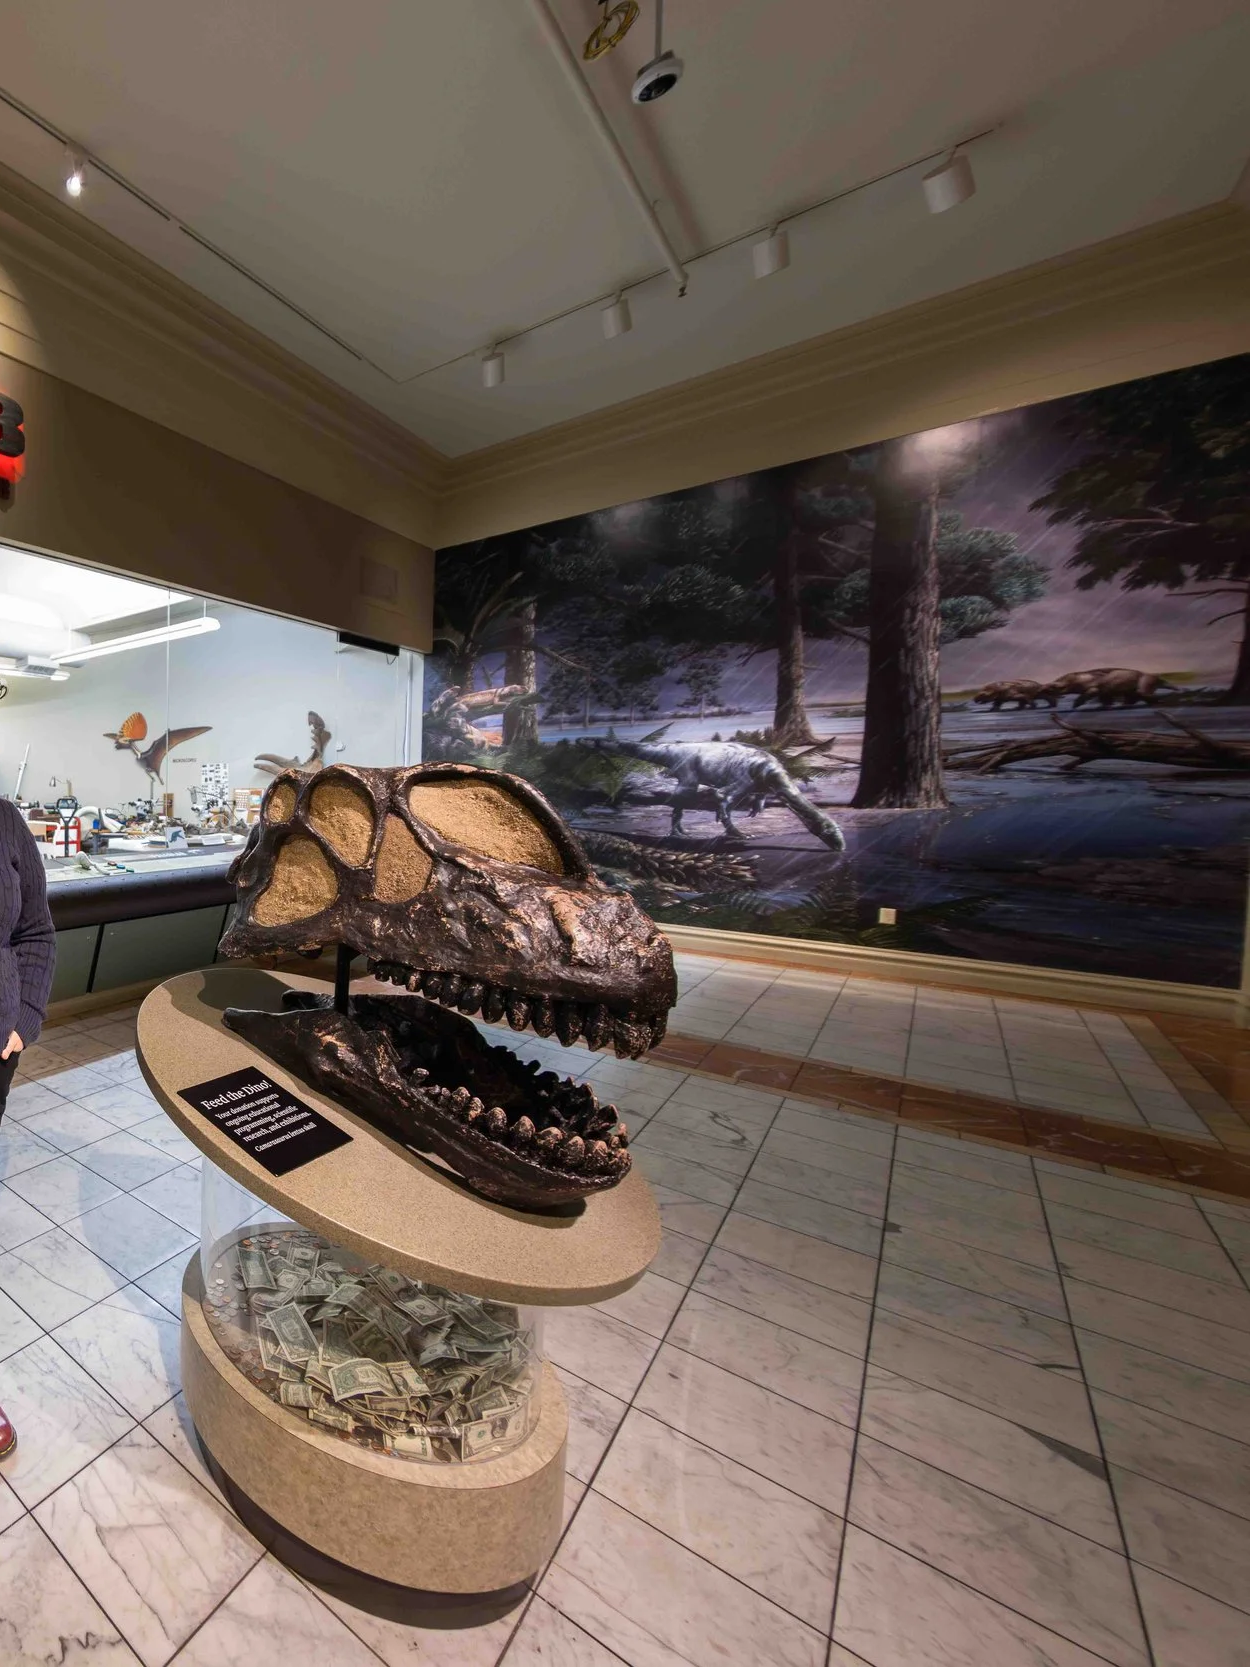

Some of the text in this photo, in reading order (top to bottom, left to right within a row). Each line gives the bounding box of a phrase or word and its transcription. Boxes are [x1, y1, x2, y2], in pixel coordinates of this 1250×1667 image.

[200, 1080, 272, 1110] Feed the Dino!
[215, 1093, 279, 1119] Your donation supports
[225, 1101, 281, 1126] ongoing educational
[233, 1106, 298, 1135] programming, scientific
[243, 1127, 271, 1142] research,
[269, 1122, 281, 1132] and
